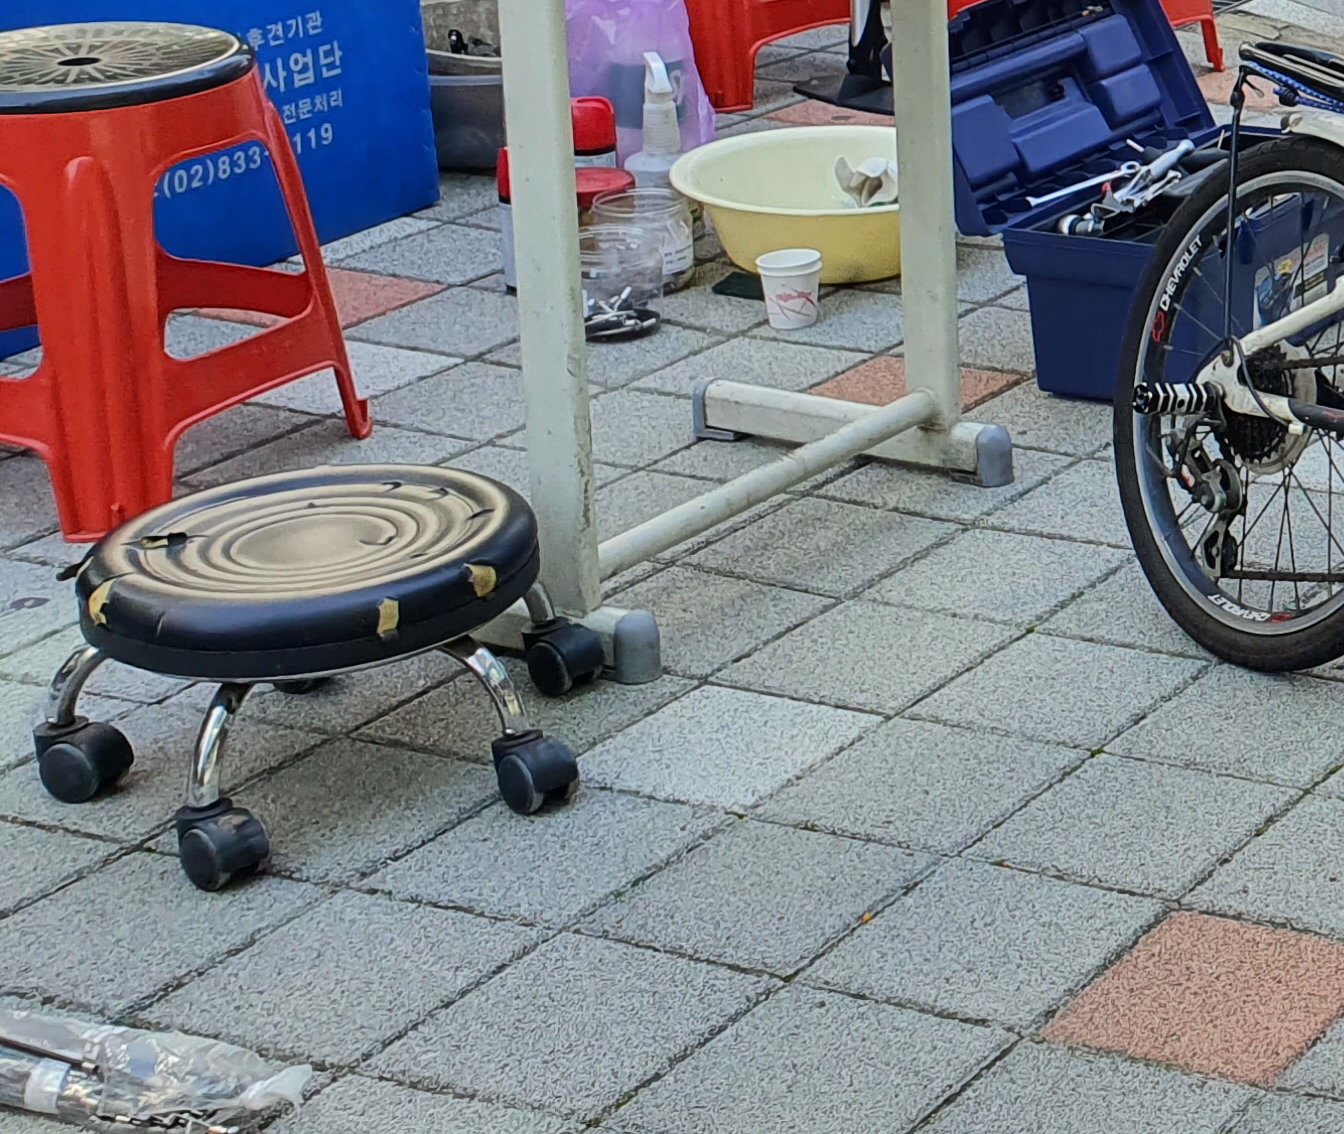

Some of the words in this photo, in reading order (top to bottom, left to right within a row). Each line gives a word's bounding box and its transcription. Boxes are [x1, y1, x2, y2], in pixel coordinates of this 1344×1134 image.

[237, 11, 323, 51] 후견기관
[282, 89, 343, 125] 전문처리
[1160, 234, 1203, 312] CHEVROLET
